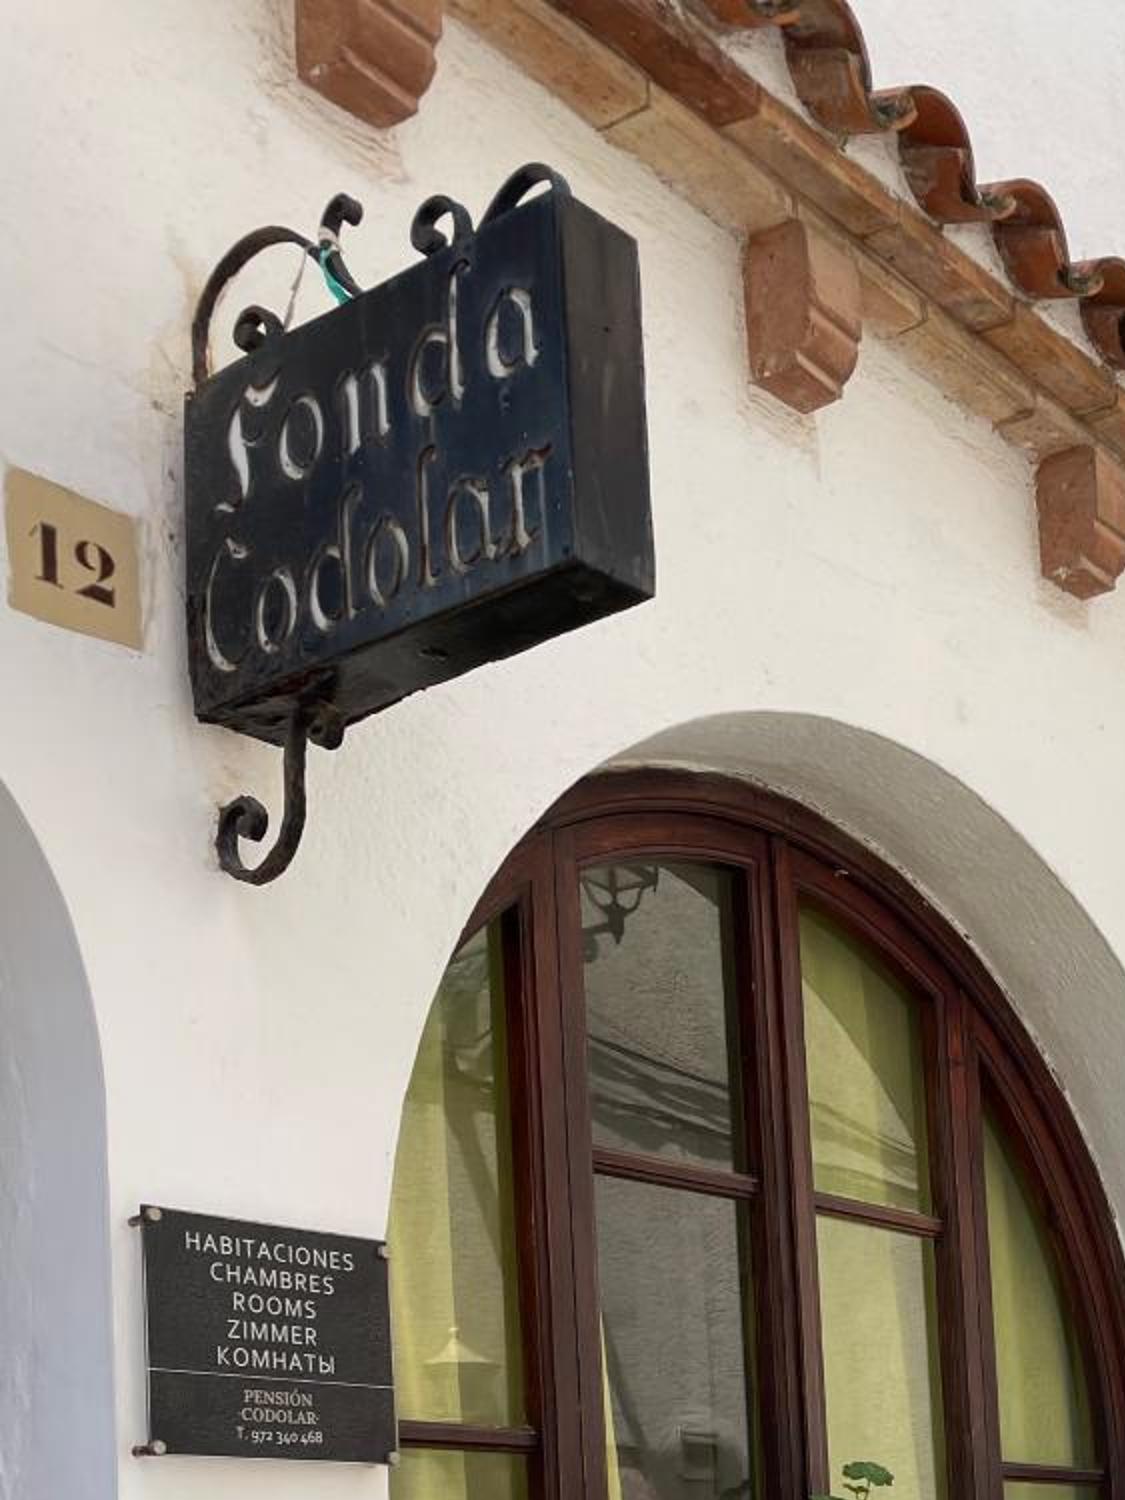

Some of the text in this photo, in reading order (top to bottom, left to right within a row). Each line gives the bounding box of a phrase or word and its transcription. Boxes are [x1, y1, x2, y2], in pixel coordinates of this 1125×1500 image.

[28, 521, 117, 609] 12
[203, 443, 552, 672] Codolar
[184, 1230, 354, 1272] HABITACIONES
[209, 1261, 335, 1296] CHAMBRES
[232, 1291, 317, 1320] ROOMS
[226, 1319, 317, 1347] ZIMMER
[216, 1345, 335, 1375] КОМНАТЫ
[243, 1388, 313, 1407] PENSIÓN
[251, 1428, 273, 1445] 972
[276, 1430, 298, 1446] 340
[300, 1430, 323, 1445] 468
